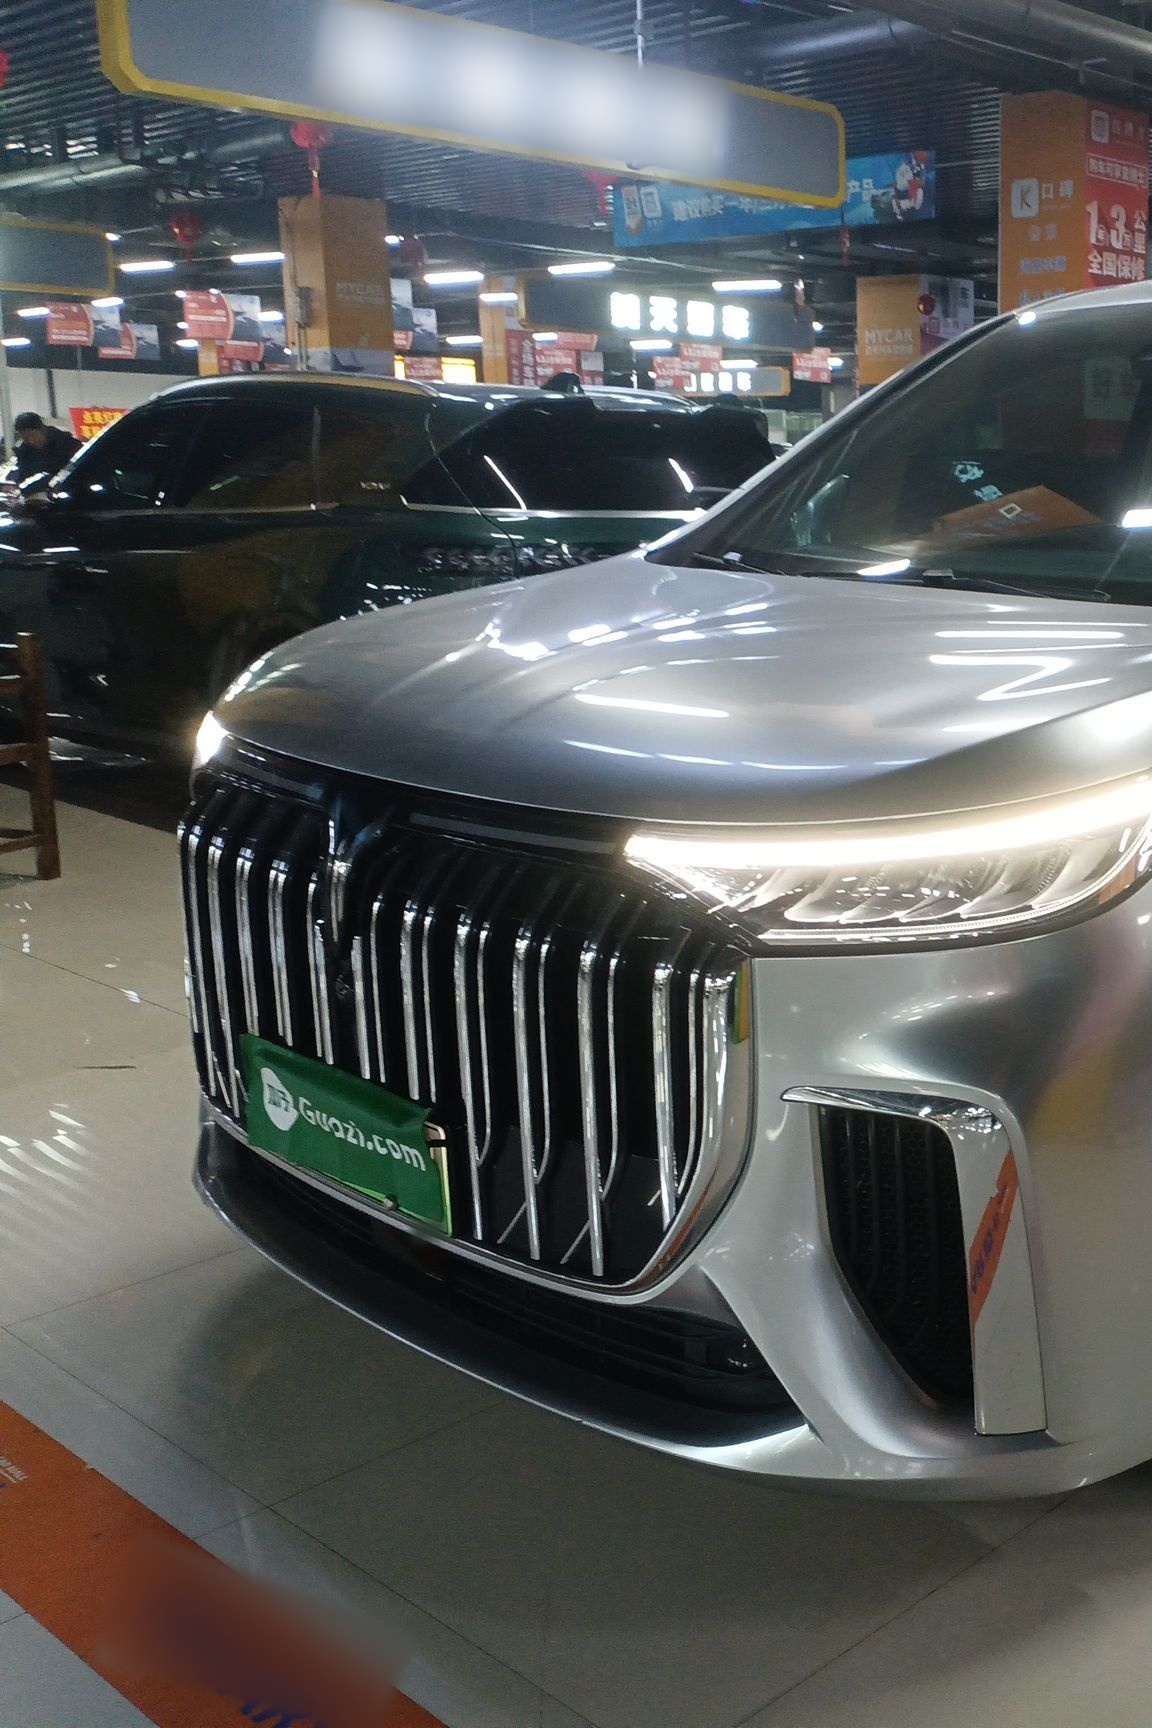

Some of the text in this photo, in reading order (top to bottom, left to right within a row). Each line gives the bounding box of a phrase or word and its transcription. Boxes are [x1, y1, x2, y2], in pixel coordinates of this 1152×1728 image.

[1087, 250, 1147, 281] 全国保修
[863, 328, 914, 344] MYCAR
[298, 1096, 427, 1172] Guazi.com
